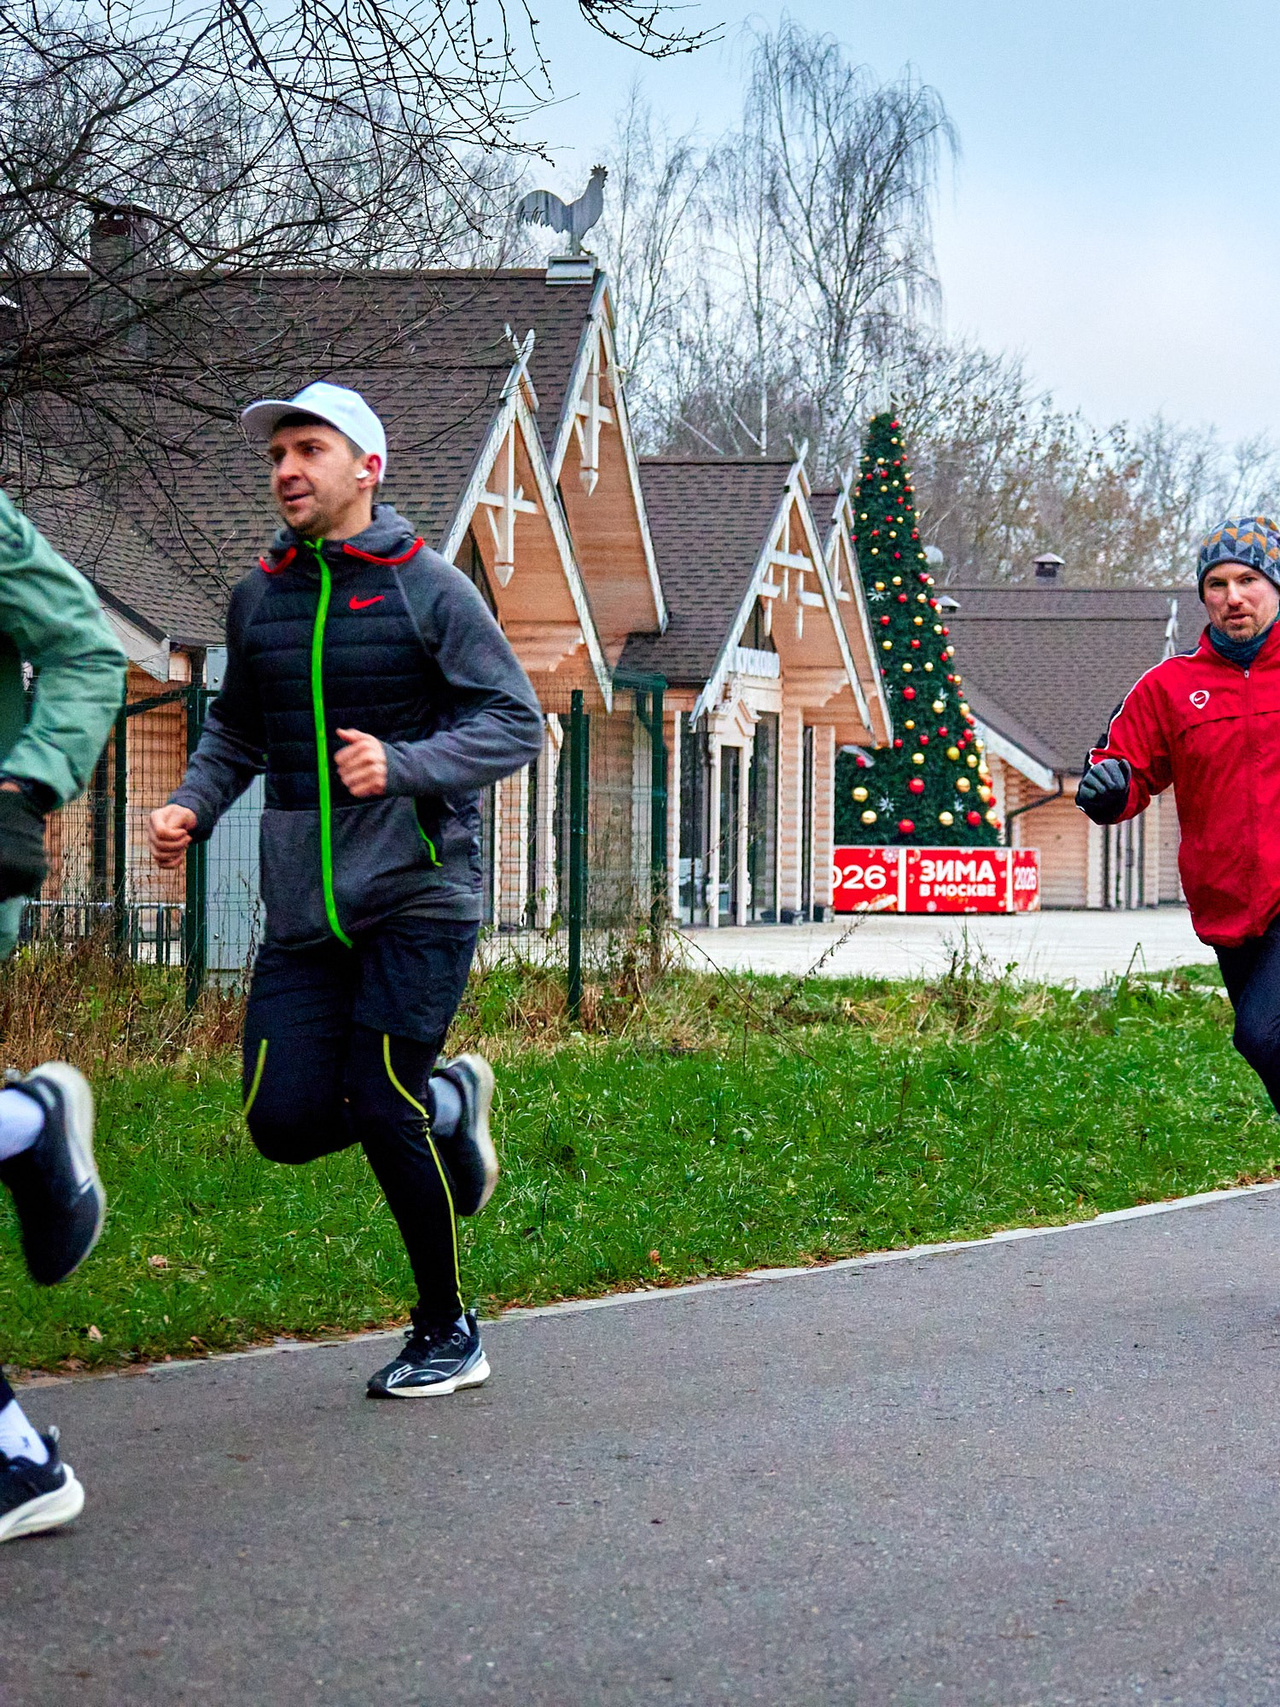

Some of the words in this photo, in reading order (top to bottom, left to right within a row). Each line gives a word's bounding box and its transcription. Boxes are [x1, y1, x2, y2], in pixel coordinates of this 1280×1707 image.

[919, 859, 997, 882] ЗИМА
[1014, 866, 1037, 890] 2026
[919, 884, 931, 897] В
[933, 884, 997, 897] МОСКВЕ
